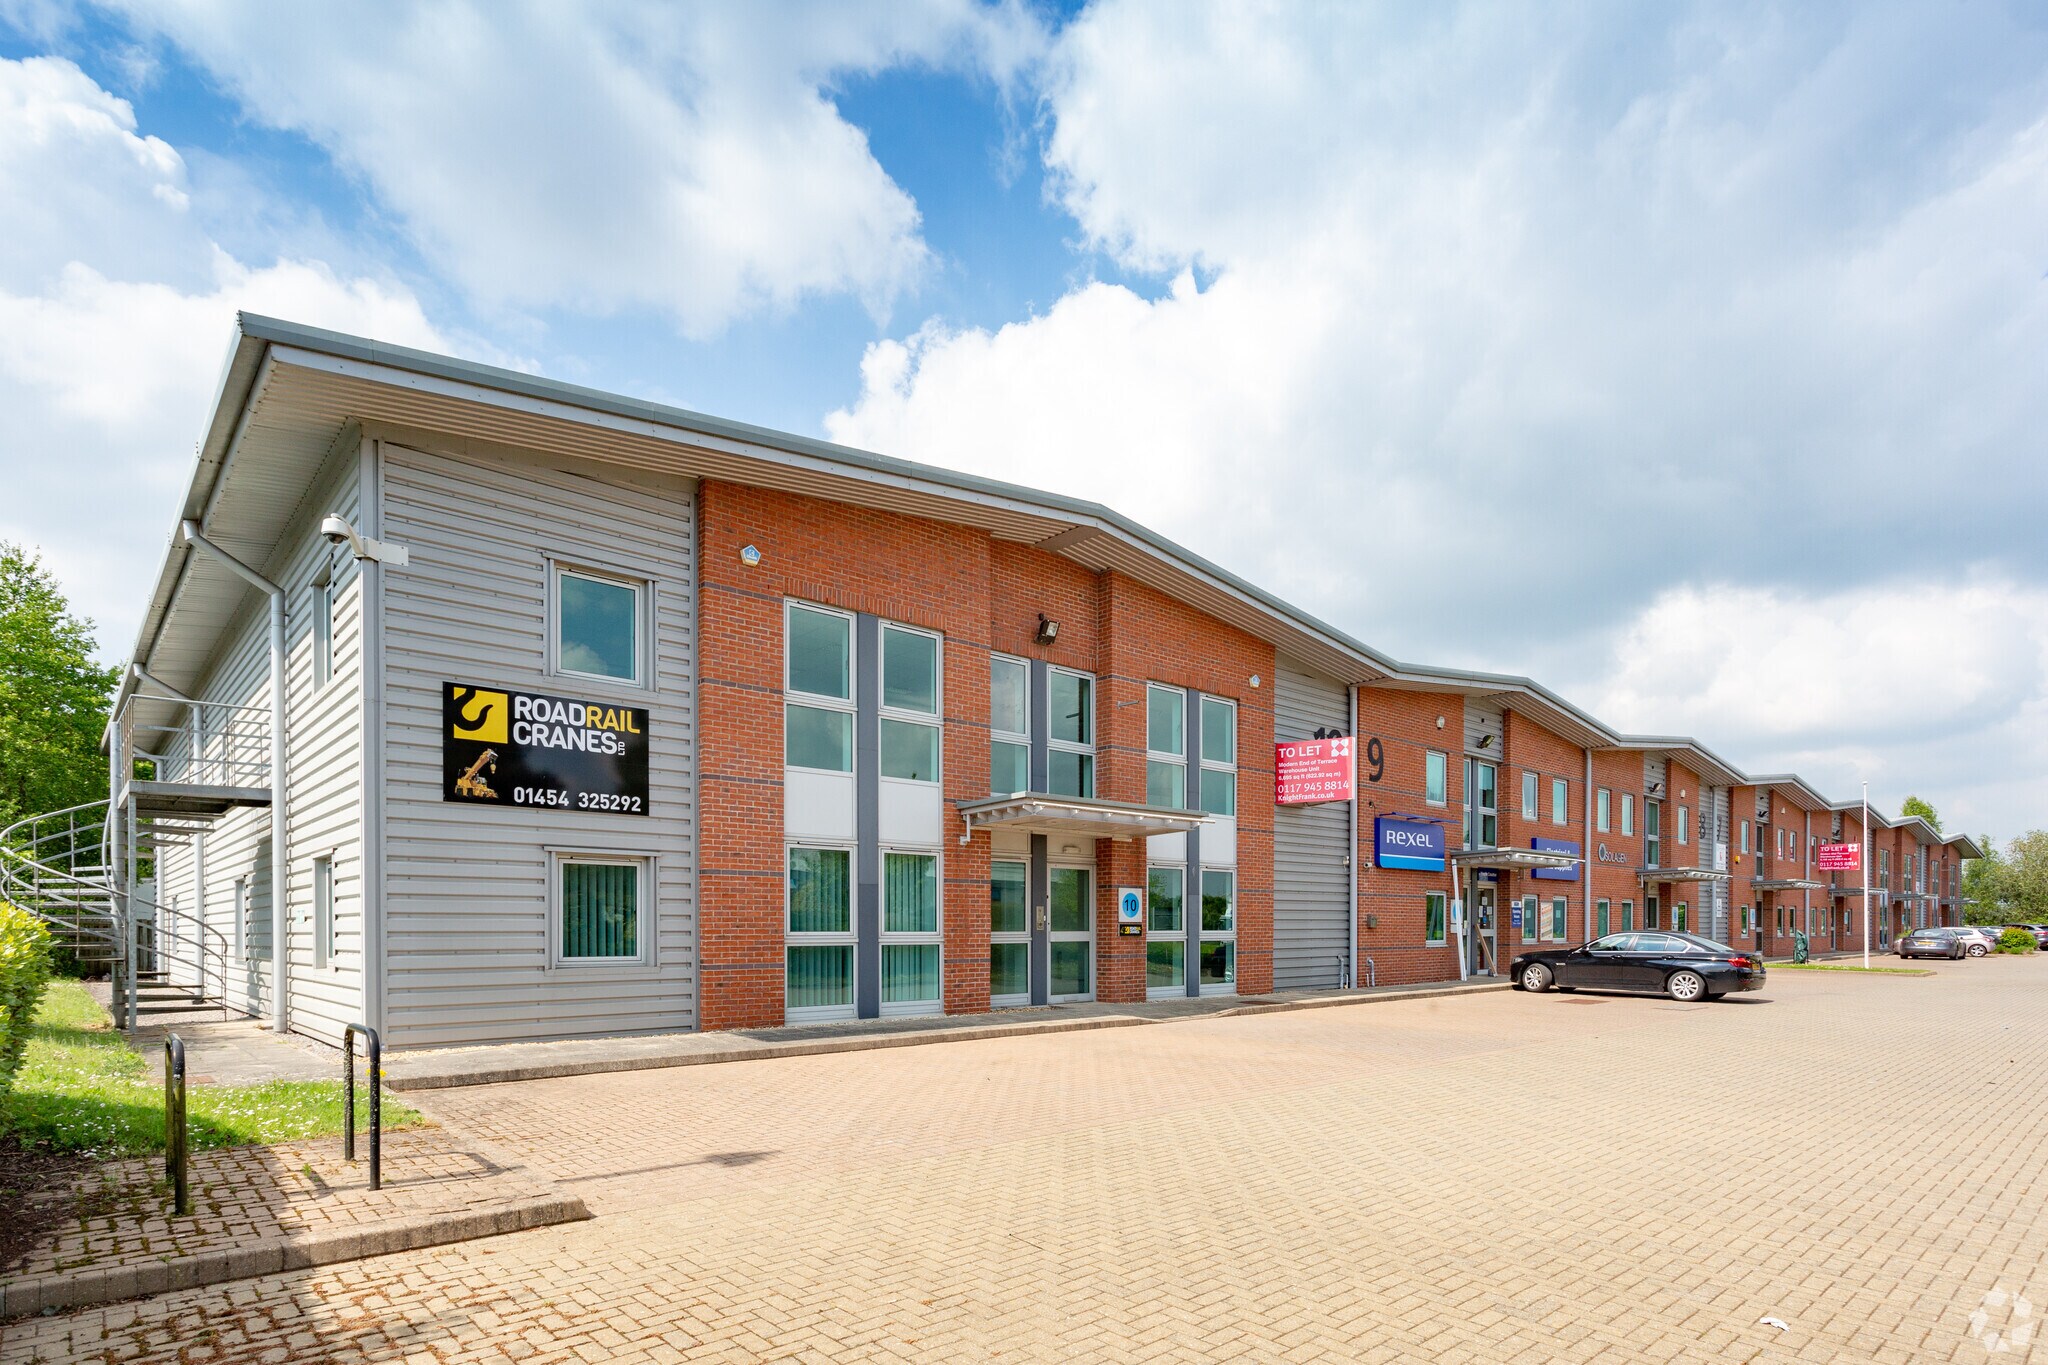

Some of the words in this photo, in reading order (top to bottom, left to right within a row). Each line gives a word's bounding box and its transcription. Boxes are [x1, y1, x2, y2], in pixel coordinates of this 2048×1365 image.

[514, 696, 641, 734] ROADRAIL
[513, 721, 618, 755] CRANES
[618, 741, 626, 756] LTD
[1278, 747, 1296, 759] TO
[1299, 745, 1322, 757] LET
[1367, 737, 1384, 783] 9
[1278, 783, 1302, 794] 0117
[1303, 782, 1322, 792] 945
[1324, 780, 1349, 791] 8814
[513, 786, 570, 807] 01454
[578, 792, 641, 812] 325292
[1278, 791, 1335, 802] KnightFrank.co.uk
[1124, 899, 1137, 912] 10
